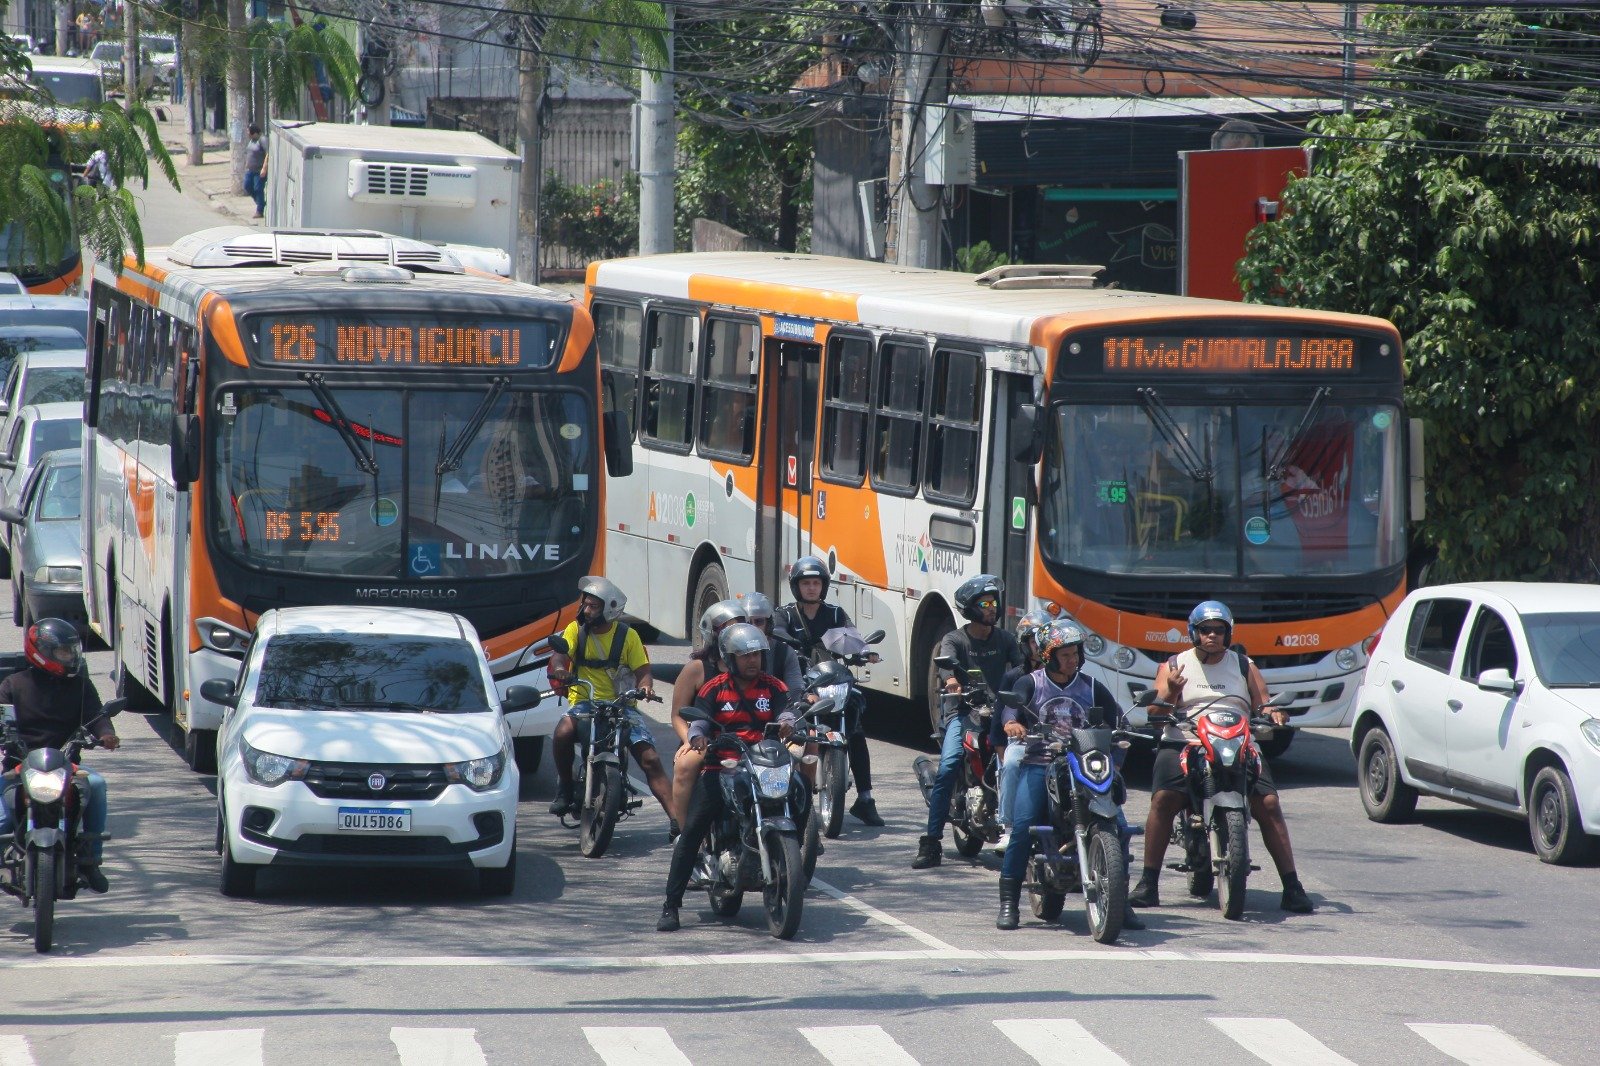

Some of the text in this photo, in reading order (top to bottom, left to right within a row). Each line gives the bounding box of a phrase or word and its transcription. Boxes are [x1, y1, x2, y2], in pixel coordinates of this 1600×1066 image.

[270, 324, 316, 361] 126
[337, 326, 412, 362] NOVA
[1103, 338, 1144, 368] 111
[1182, 338, 1355, 369] GUADALAJARA
[265, 511, 340, 541] R$ 5.95
[445, 542, 560, 561] LINAVE
[895, 542, 965, 579] NVA IGUAÇU
[355, 588, 458, 600] MASCARELLO
[1145, 633, 1168, 642] NOVA
[1274, 633, 1320, 647] A02038
[371, 778, 382, 787] FIAT
[344, 814, 403, 829] QUI5D86
